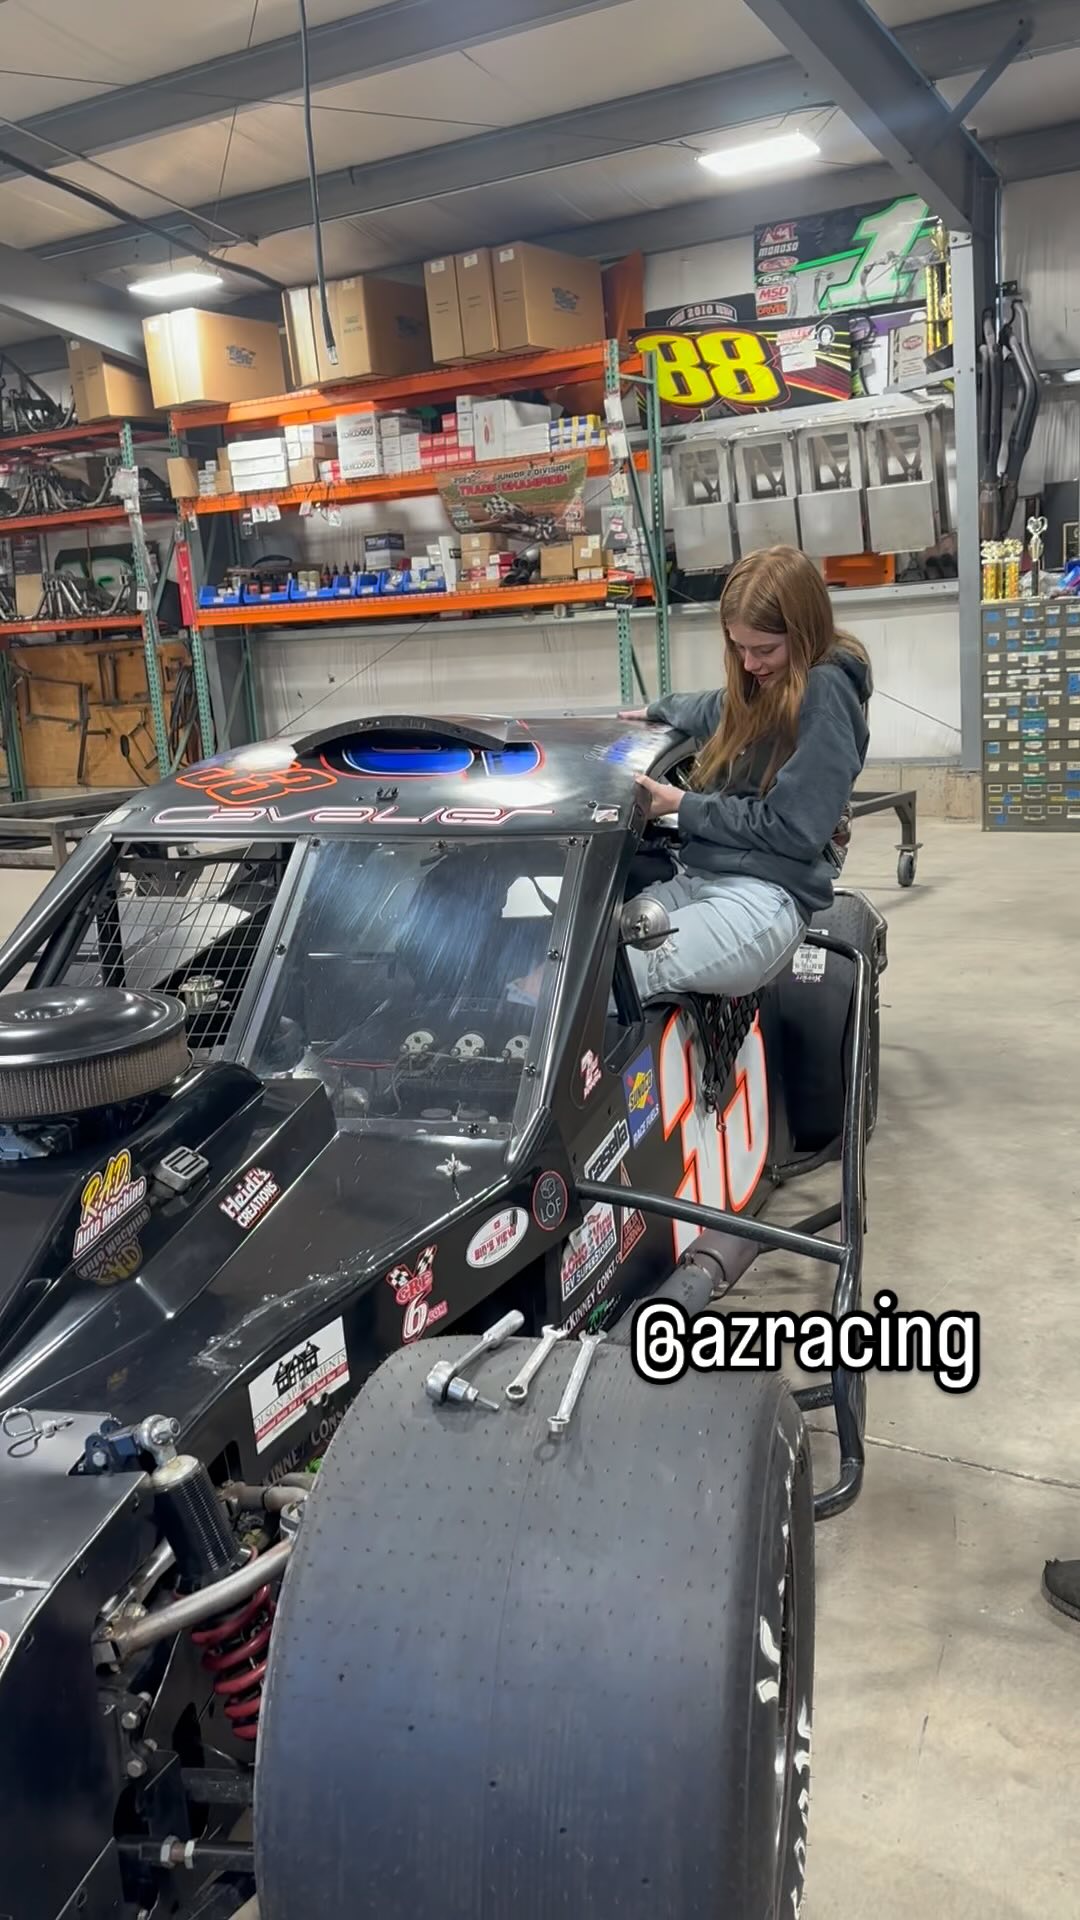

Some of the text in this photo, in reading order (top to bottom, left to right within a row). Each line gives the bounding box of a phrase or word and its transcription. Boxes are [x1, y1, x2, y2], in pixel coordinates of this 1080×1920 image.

[758, 241, 799, 257] MOROSO
[759, 286, 789, 299] MSD
[635, 328, 782, 408] 88
[76, 1179, 146, 1250] Auto Machine
[219, 1168, 278, 1228] Heidi's CREATIONS
[564, 1276, 577, 1294] RV
[577, 1231, 615, 1283] SUPERSTORES
